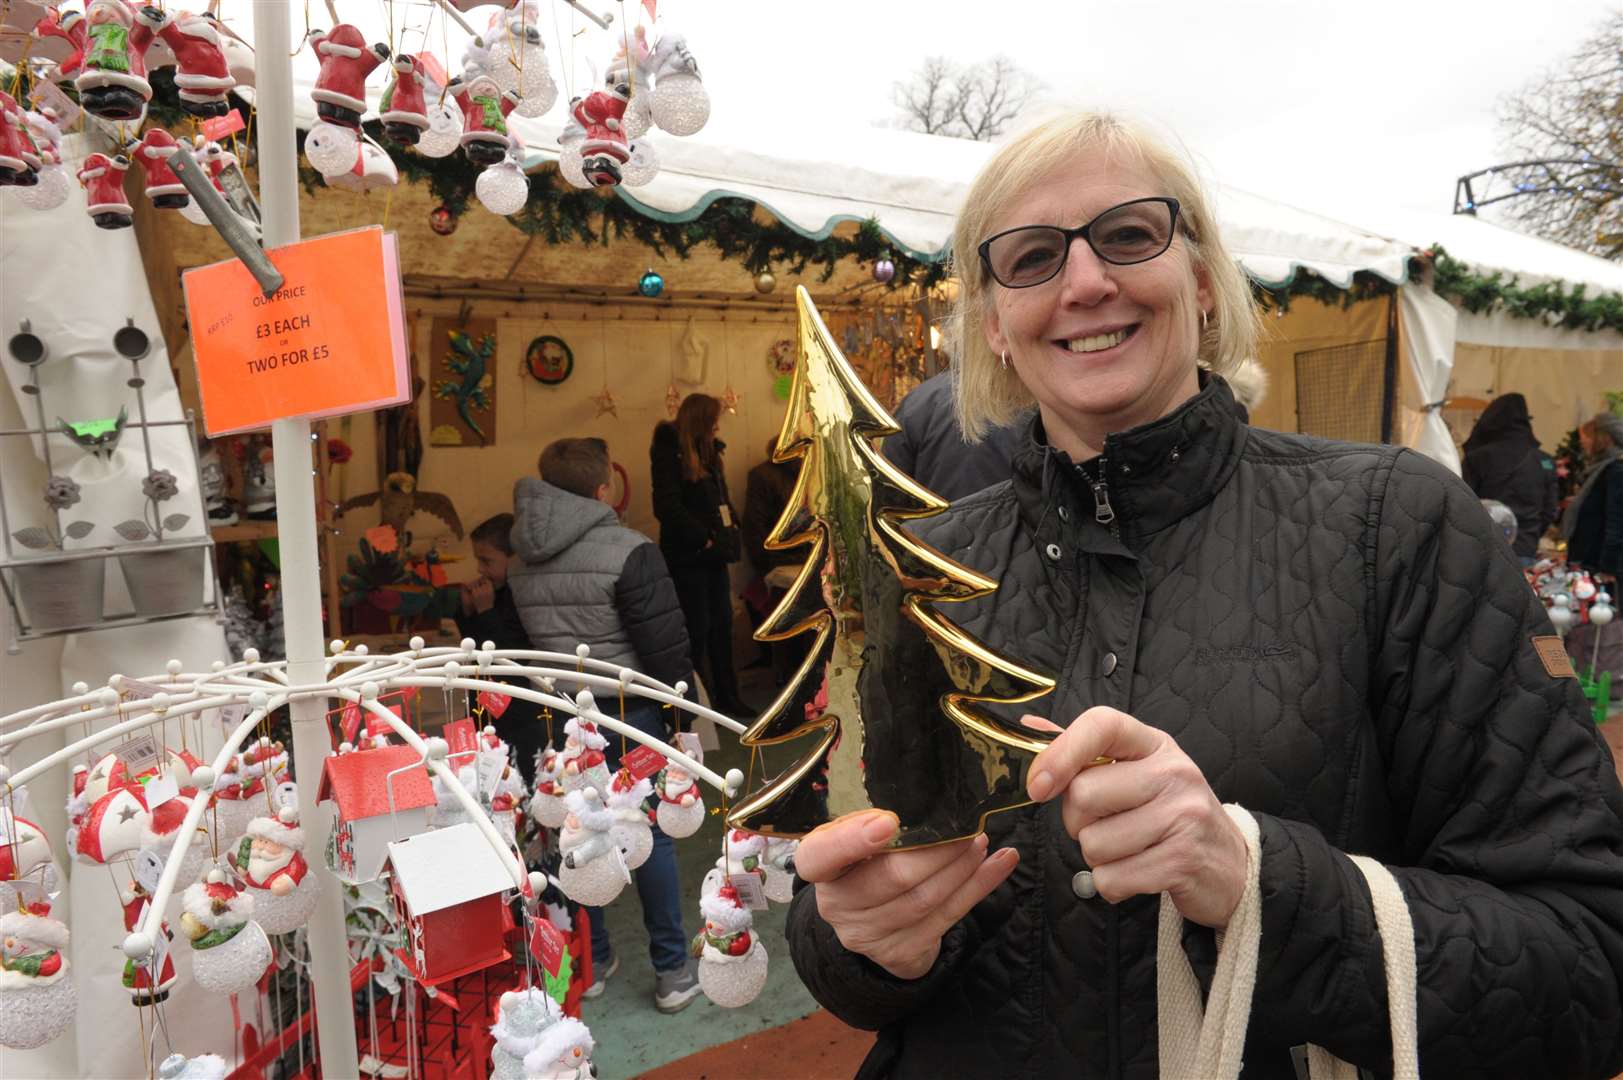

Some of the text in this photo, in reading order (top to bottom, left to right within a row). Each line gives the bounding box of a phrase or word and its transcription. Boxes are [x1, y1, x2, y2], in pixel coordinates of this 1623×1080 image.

[276, 286, 305, 301] PRICE
[256, 314, 310, 339] £3 EACH
[247, 345, 329, 374] TWO FOR £5
